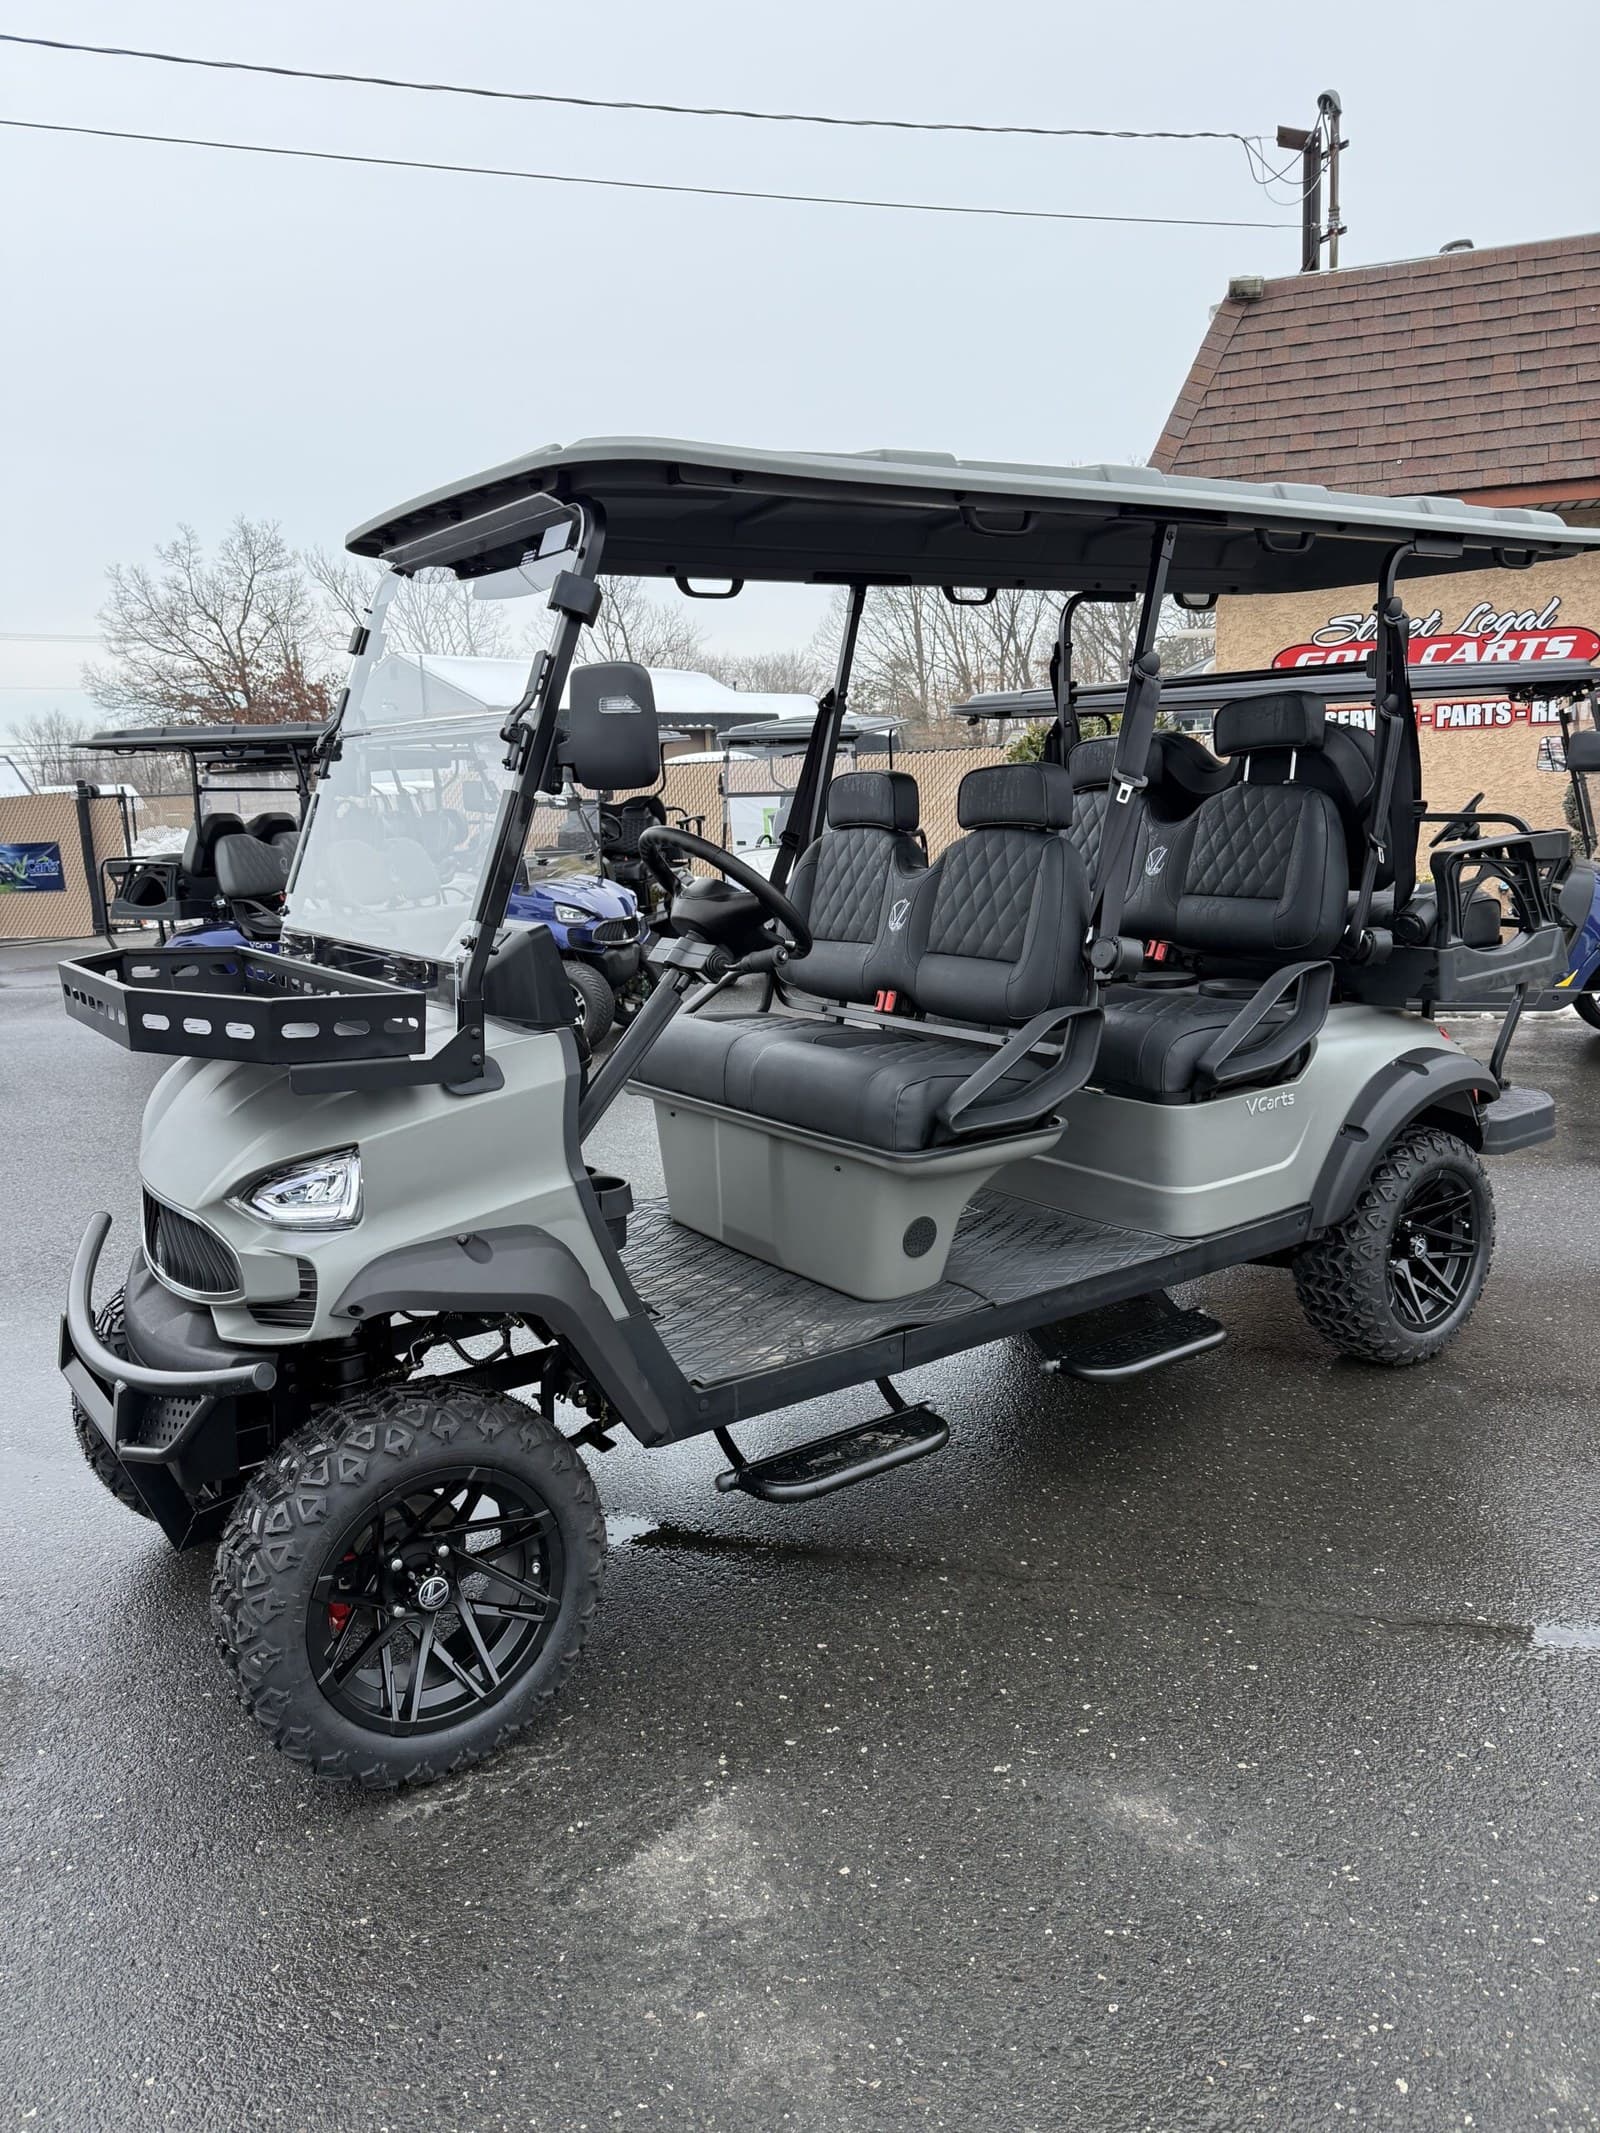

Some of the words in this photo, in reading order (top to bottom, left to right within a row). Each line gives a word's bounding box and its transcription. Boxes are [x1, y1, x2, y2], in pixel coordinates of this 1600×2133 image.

[1312, 609, 1442, 648] Stet
[1451, 596, 1562, 644] Legal
[1420, 635, 1577, 665] CARTS
[1436, 701, 1512, 728] PARTS
[1246, 1091, 1295, 1116] VCarts
